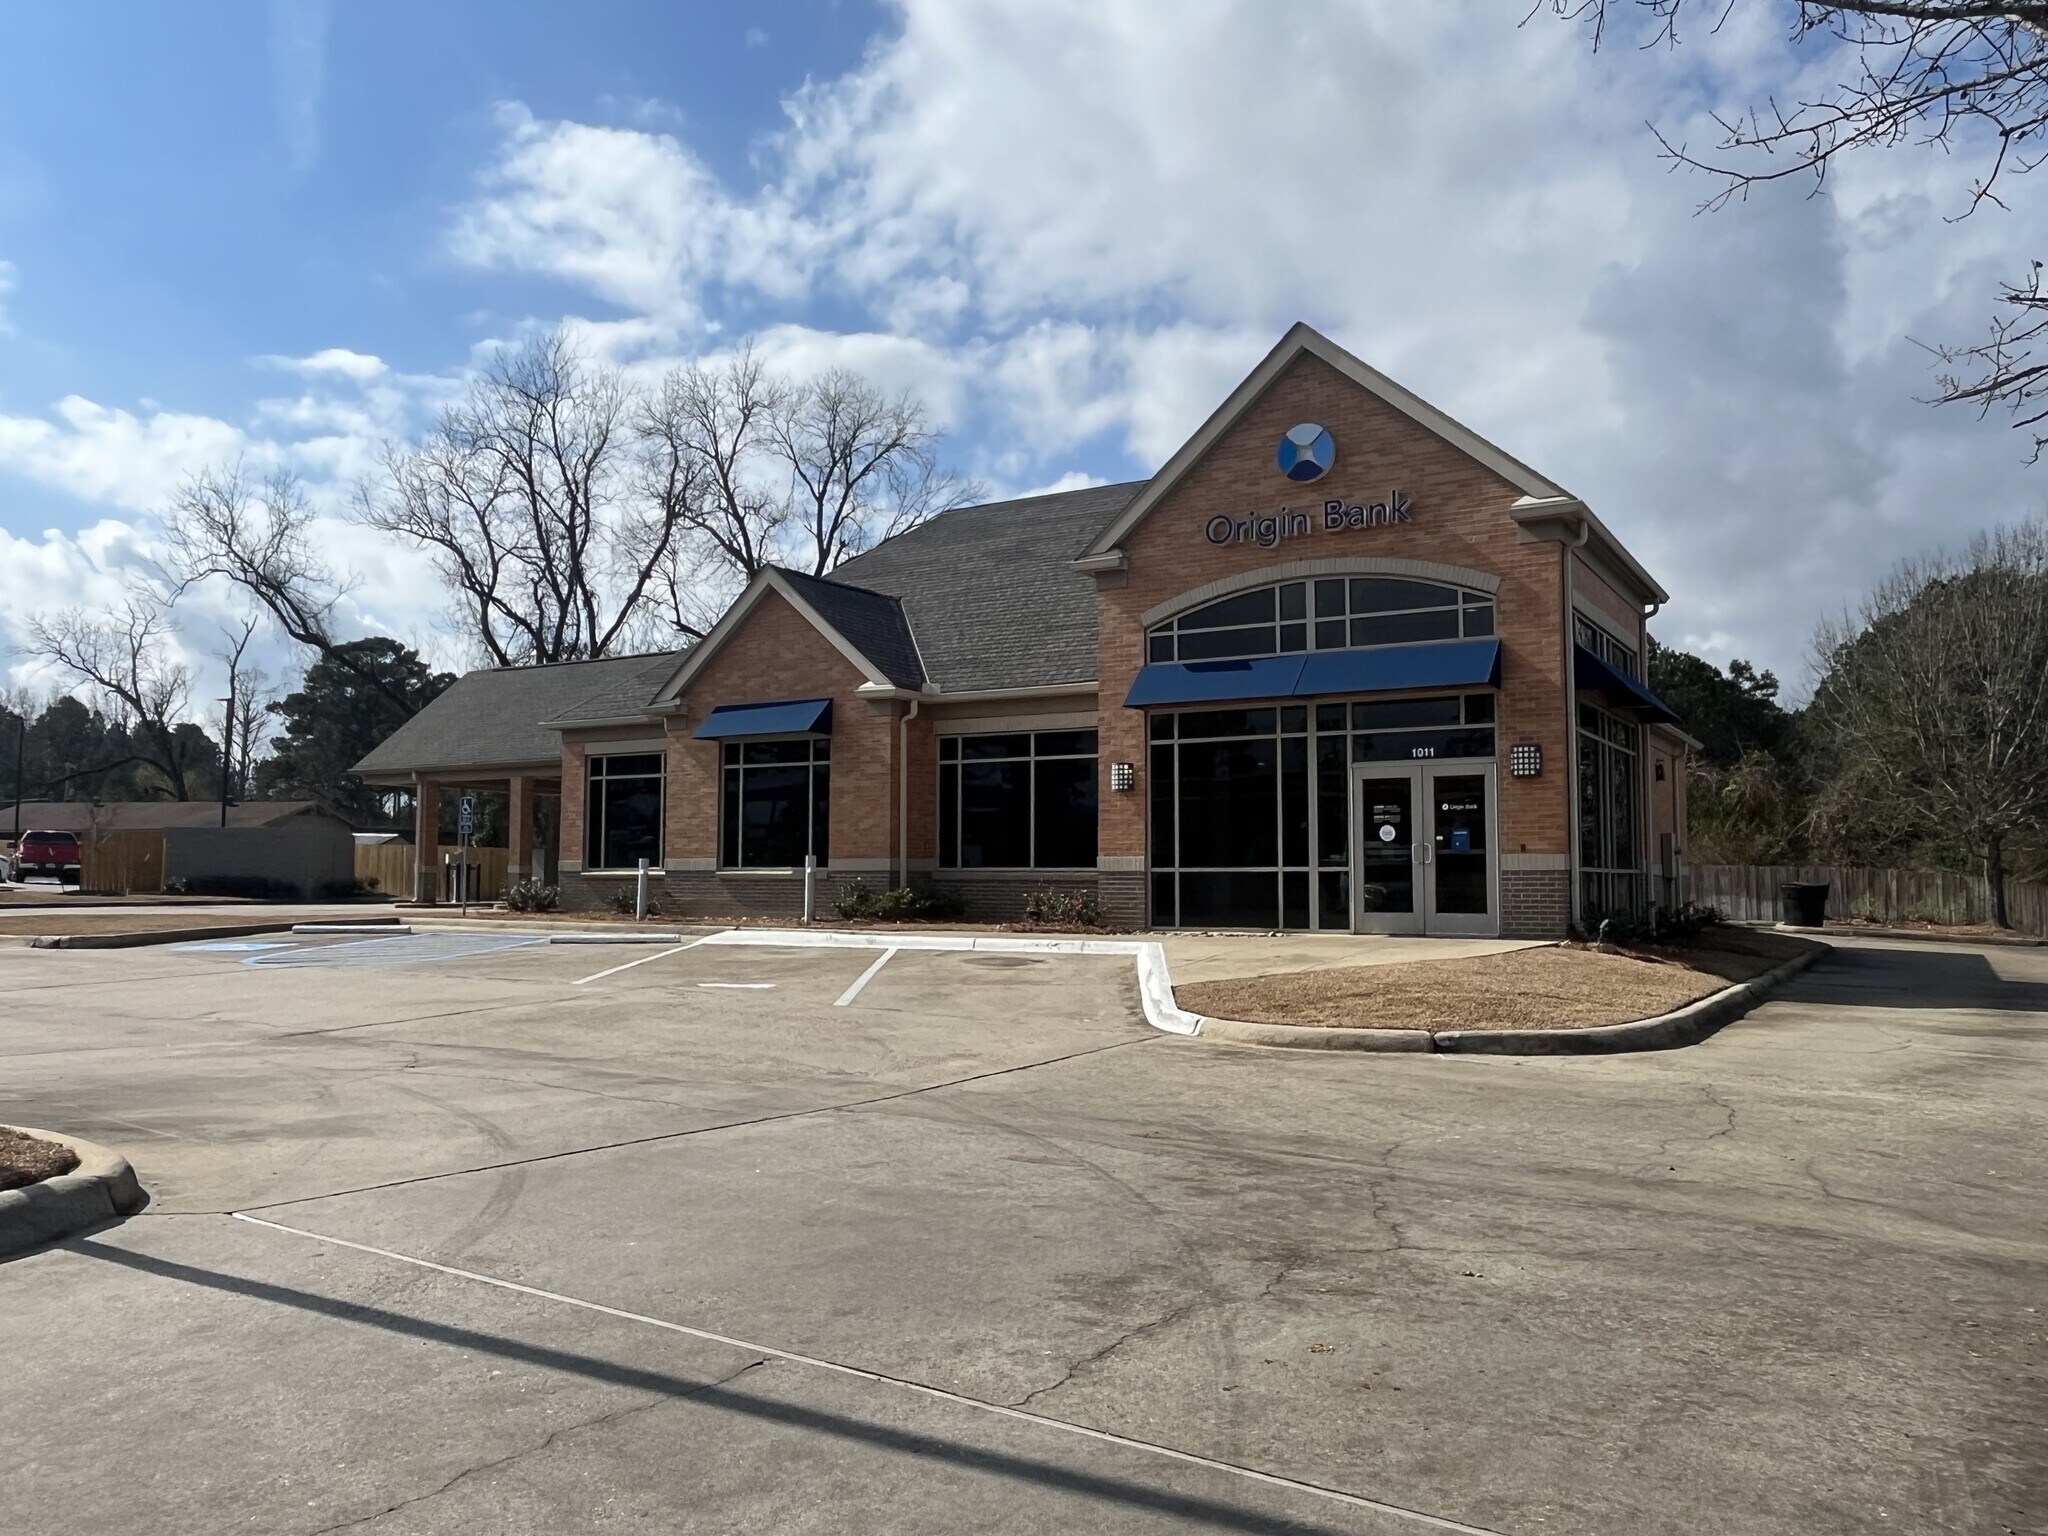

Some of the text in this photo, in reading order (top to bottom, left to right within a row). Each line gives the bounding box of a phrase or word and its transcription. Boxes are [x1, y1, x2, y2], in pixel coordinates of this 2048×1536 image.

[1205, 489, 1415, 548] Origin Bank
[1412, 747, 1434, 758] 1011
